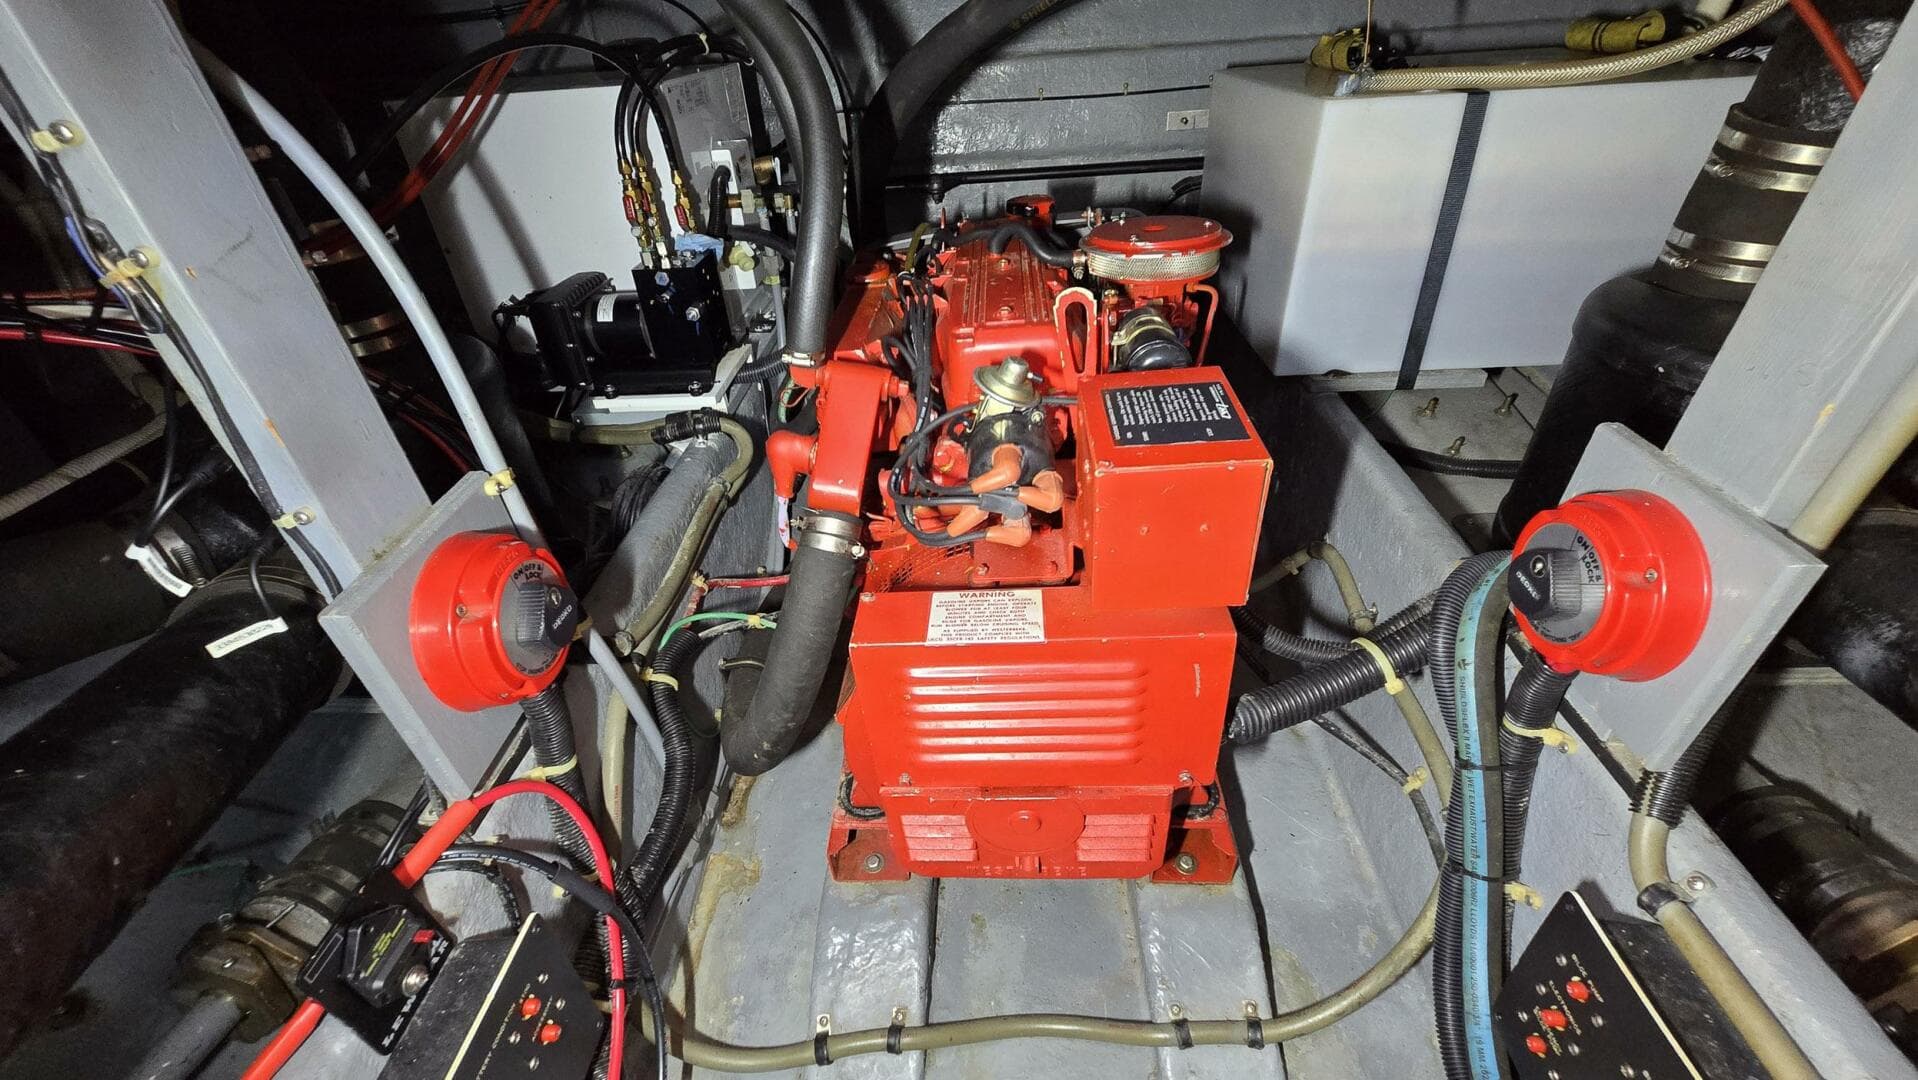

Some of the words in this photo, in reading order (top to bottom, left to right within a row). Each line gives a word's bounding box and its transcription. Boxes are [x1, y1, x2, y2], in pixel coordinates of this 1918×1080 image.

[1578, 536, 1590, 550] ON
[1588, 552, 1600, 574] OFF
[1582, 555, 1594, 582] LOCK
[513, 568, 524, 580] ON
[525, 571, 542, 580] LOCK
[1463, 742, 1472, 777] MARE
[382, 940, 449, 1047] LEWAR
